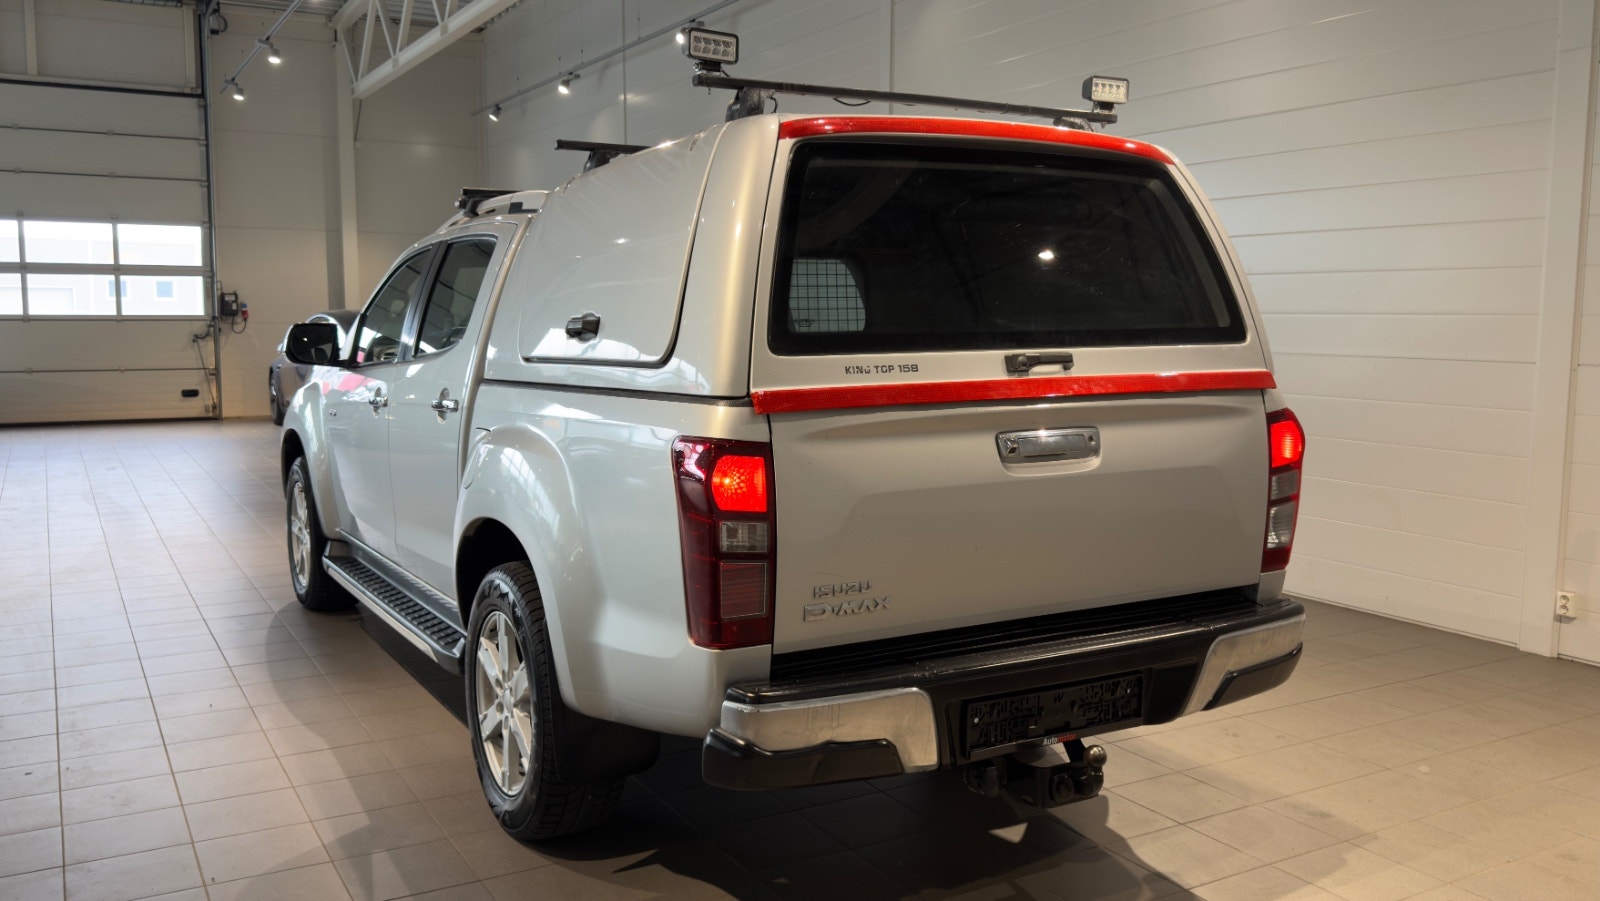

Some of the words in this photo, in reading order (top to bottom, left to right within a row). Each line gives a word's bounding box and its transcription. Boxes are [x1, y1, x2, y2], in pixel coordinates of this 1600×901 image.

[844, 365, 871, 375] KING
[873, 364, 895, 374] TOP
[897, 363, 919, 373] 158
[812, 580, 872, 600] ISUZU
